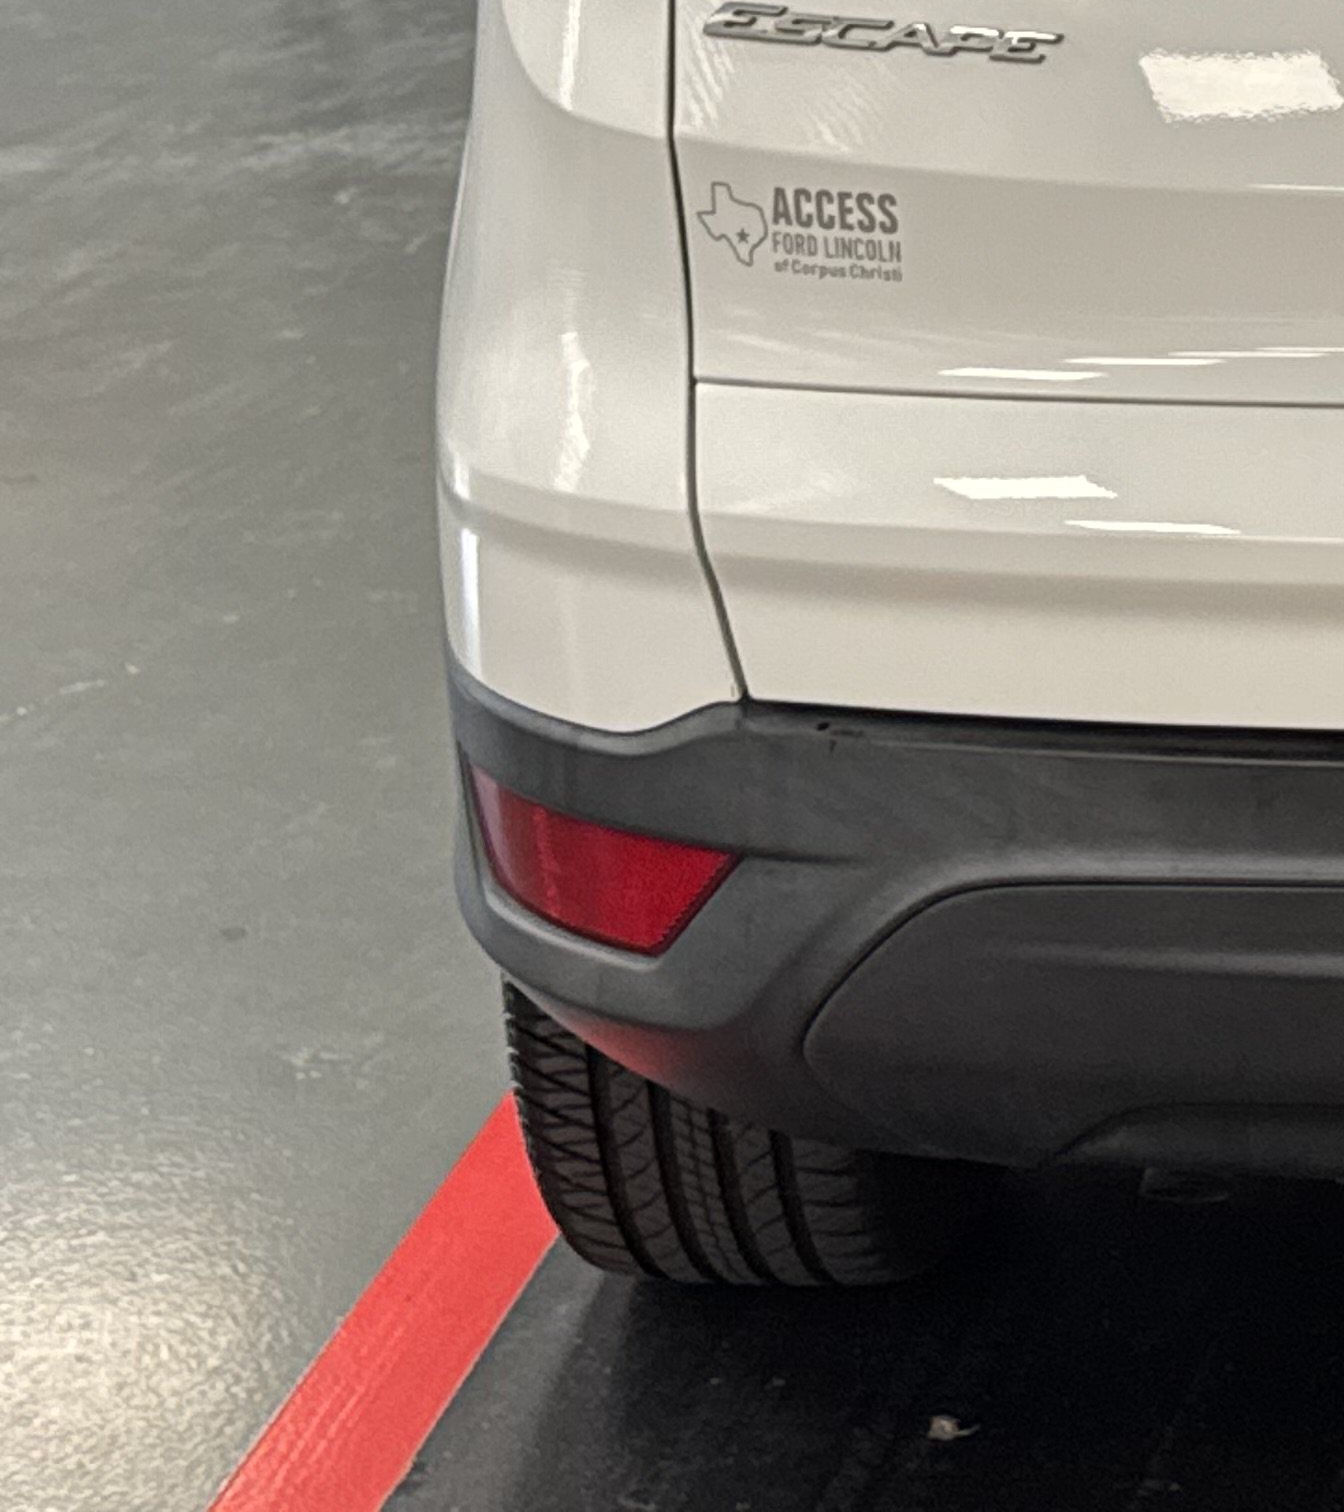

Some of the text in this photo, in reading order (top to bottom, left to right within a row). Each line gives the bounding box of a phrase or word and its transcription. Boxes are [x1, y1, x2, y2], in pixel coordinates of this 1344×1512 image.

[702, 1, 1065, 65] ESCAPE
[771, 186, 899, 235] ACCESS
[771, 231, 902, 263] FORD LINCOLN
[791, 259, 847, 280] Corpus
